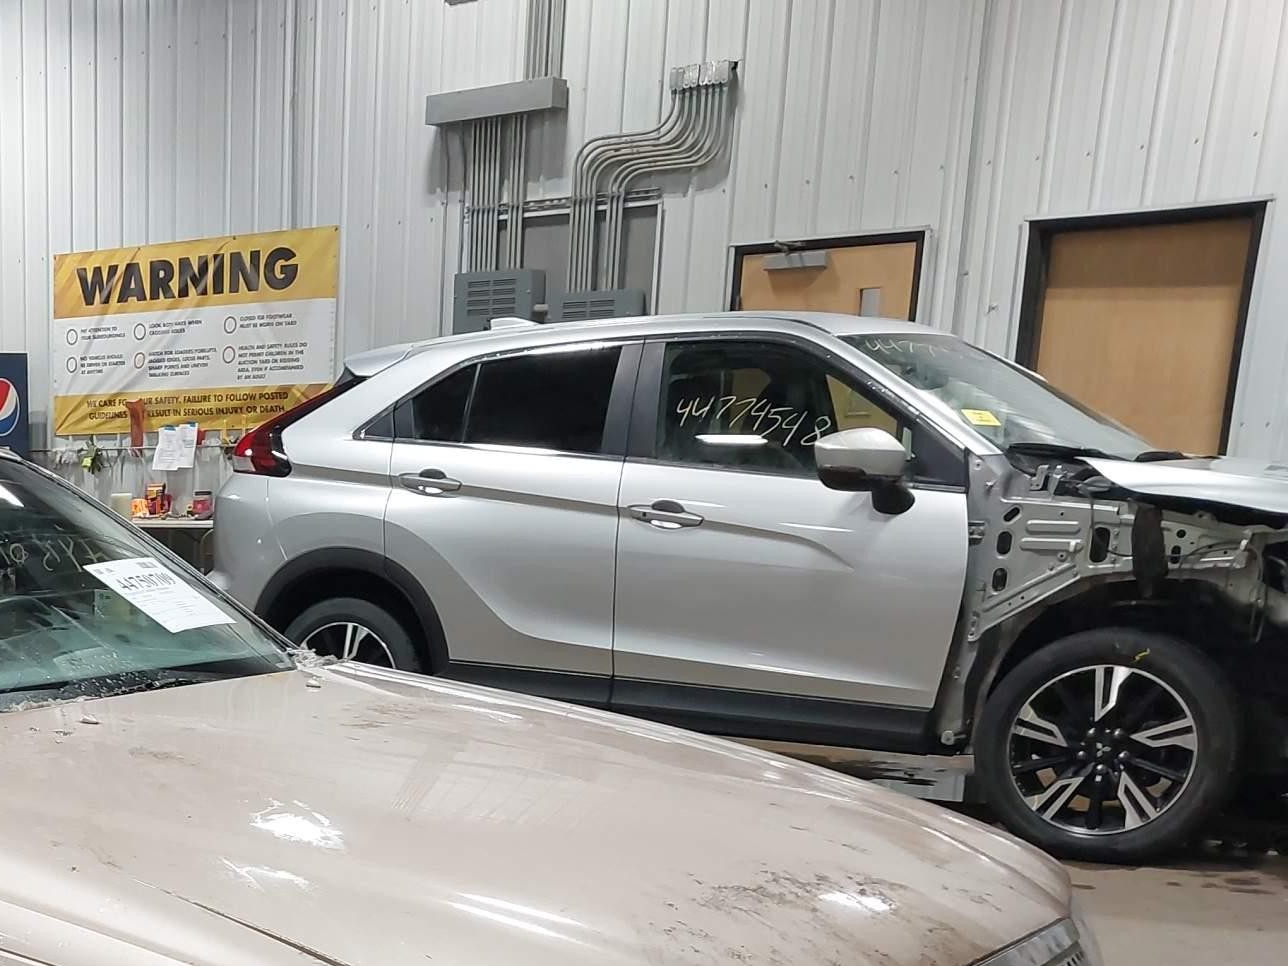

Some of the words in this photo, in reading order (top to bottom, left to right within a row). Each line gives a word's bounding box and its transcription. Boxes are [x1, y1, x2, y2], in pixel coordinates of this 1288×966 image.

[76, 247, 298, 306] WARNING
[89, 411, 127, 420] GUIDELINES
[173, 408, 181, 416] IN
[183, 407, 213, 416] SERIOUS
[215, 406, 243, 415] INJURY
[246, 405, 257, 414] OR
[260, 405, 285, 413] DEATH
[98, 399, 116, 407] CARE
[183, 395, 211, 403] FAILURE
[214, 394, 223, 402] TO
[225, 393, 257, 401] FOLLOW
[259, 392, 288, 400] POSTED
[676, 396, 831, 447] 44774548
